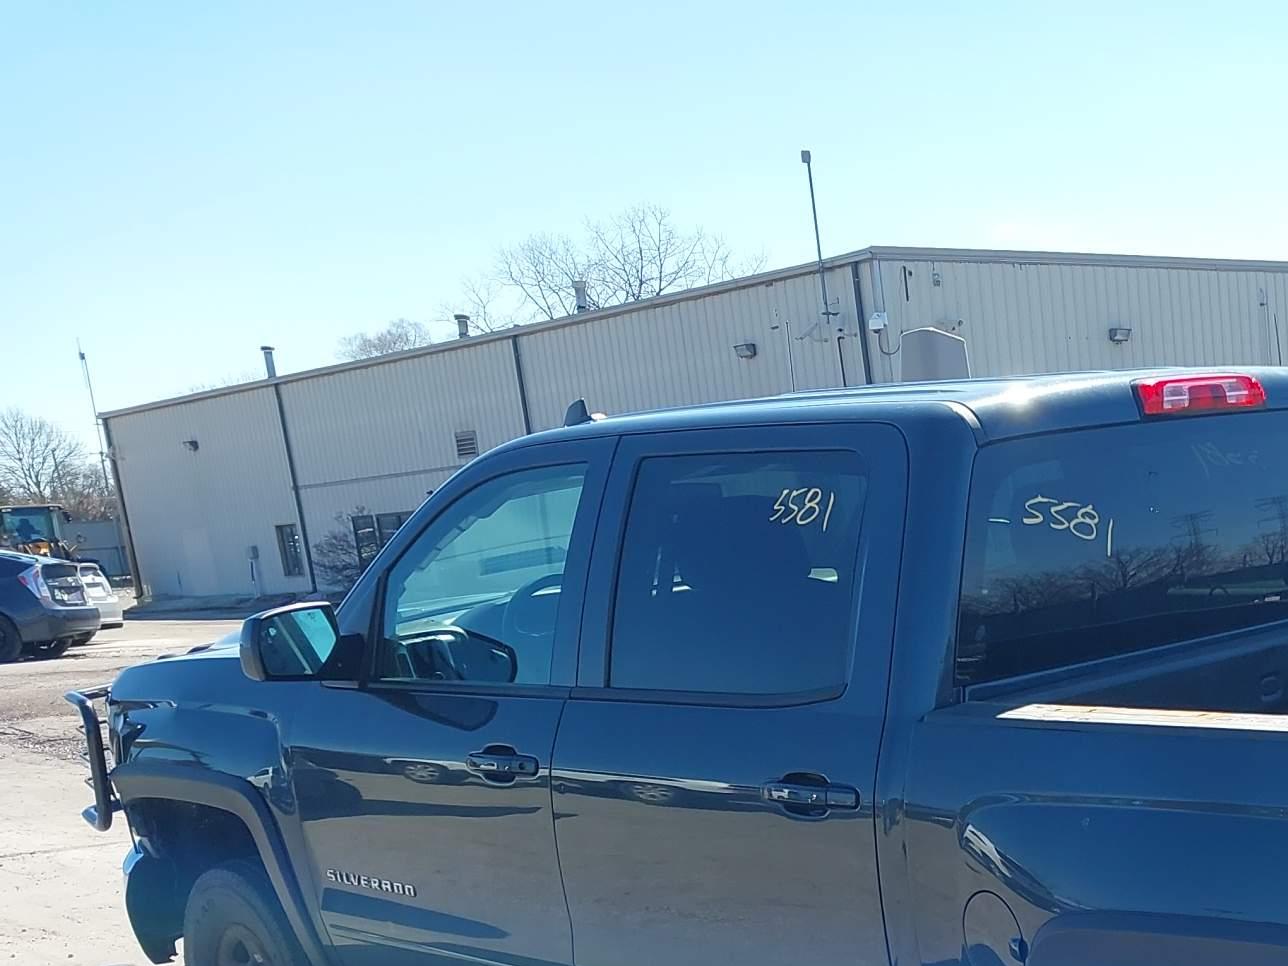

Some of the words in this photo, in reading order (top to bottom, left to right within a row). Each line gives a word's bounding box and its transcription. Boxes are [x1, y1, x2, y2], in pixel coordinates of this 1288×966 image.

[769, 487, 835, 533] 5581
[1022, 494, 1114, 557] 5581
[326, 869, 417, 897] SILVERADO
